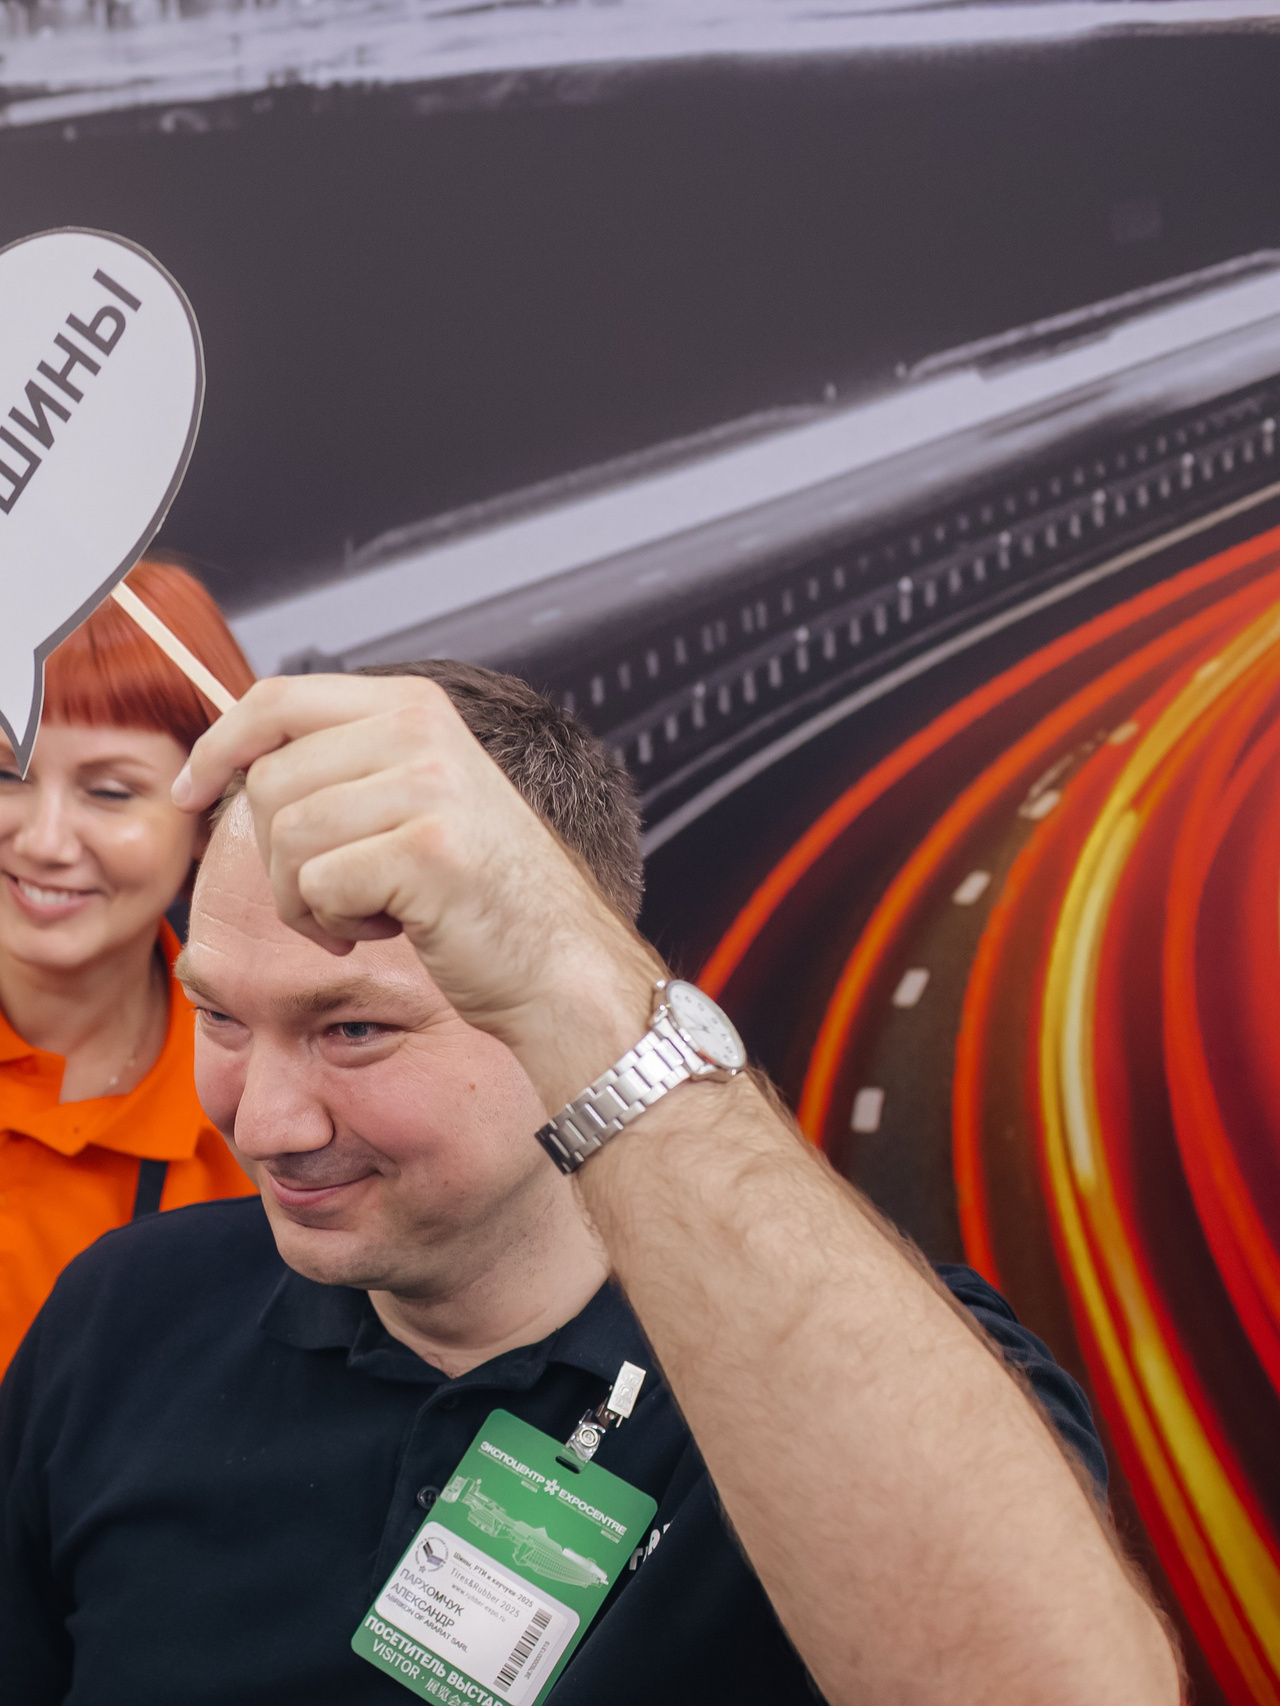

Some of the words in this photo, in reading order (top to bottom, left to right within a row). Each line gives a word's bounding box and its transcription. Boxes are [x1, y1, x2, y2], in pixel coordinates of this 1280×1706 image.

[480, 1441, 545, 1483] ЭКСПОЦЕНТР
[558, 1489, 628, 1536] EXPOCENTRE
[399, 1568, 465, 1616] ПАРХОМЧУК
[450, 1567, 500, 1604] Tires&Rubber
[500, 1599, 520, 1618] 2025
[473, 1564, 489, 1579] РТИ
[391, 1582, 455, 1628] АЛЕКСАНДР
[364, 1615, 446, 1678] ПОСЕТИТЕЛЬ
[423, 1619, 451, 1640] ARARAT
[372, 1639, 420, 1680] VISITOR
